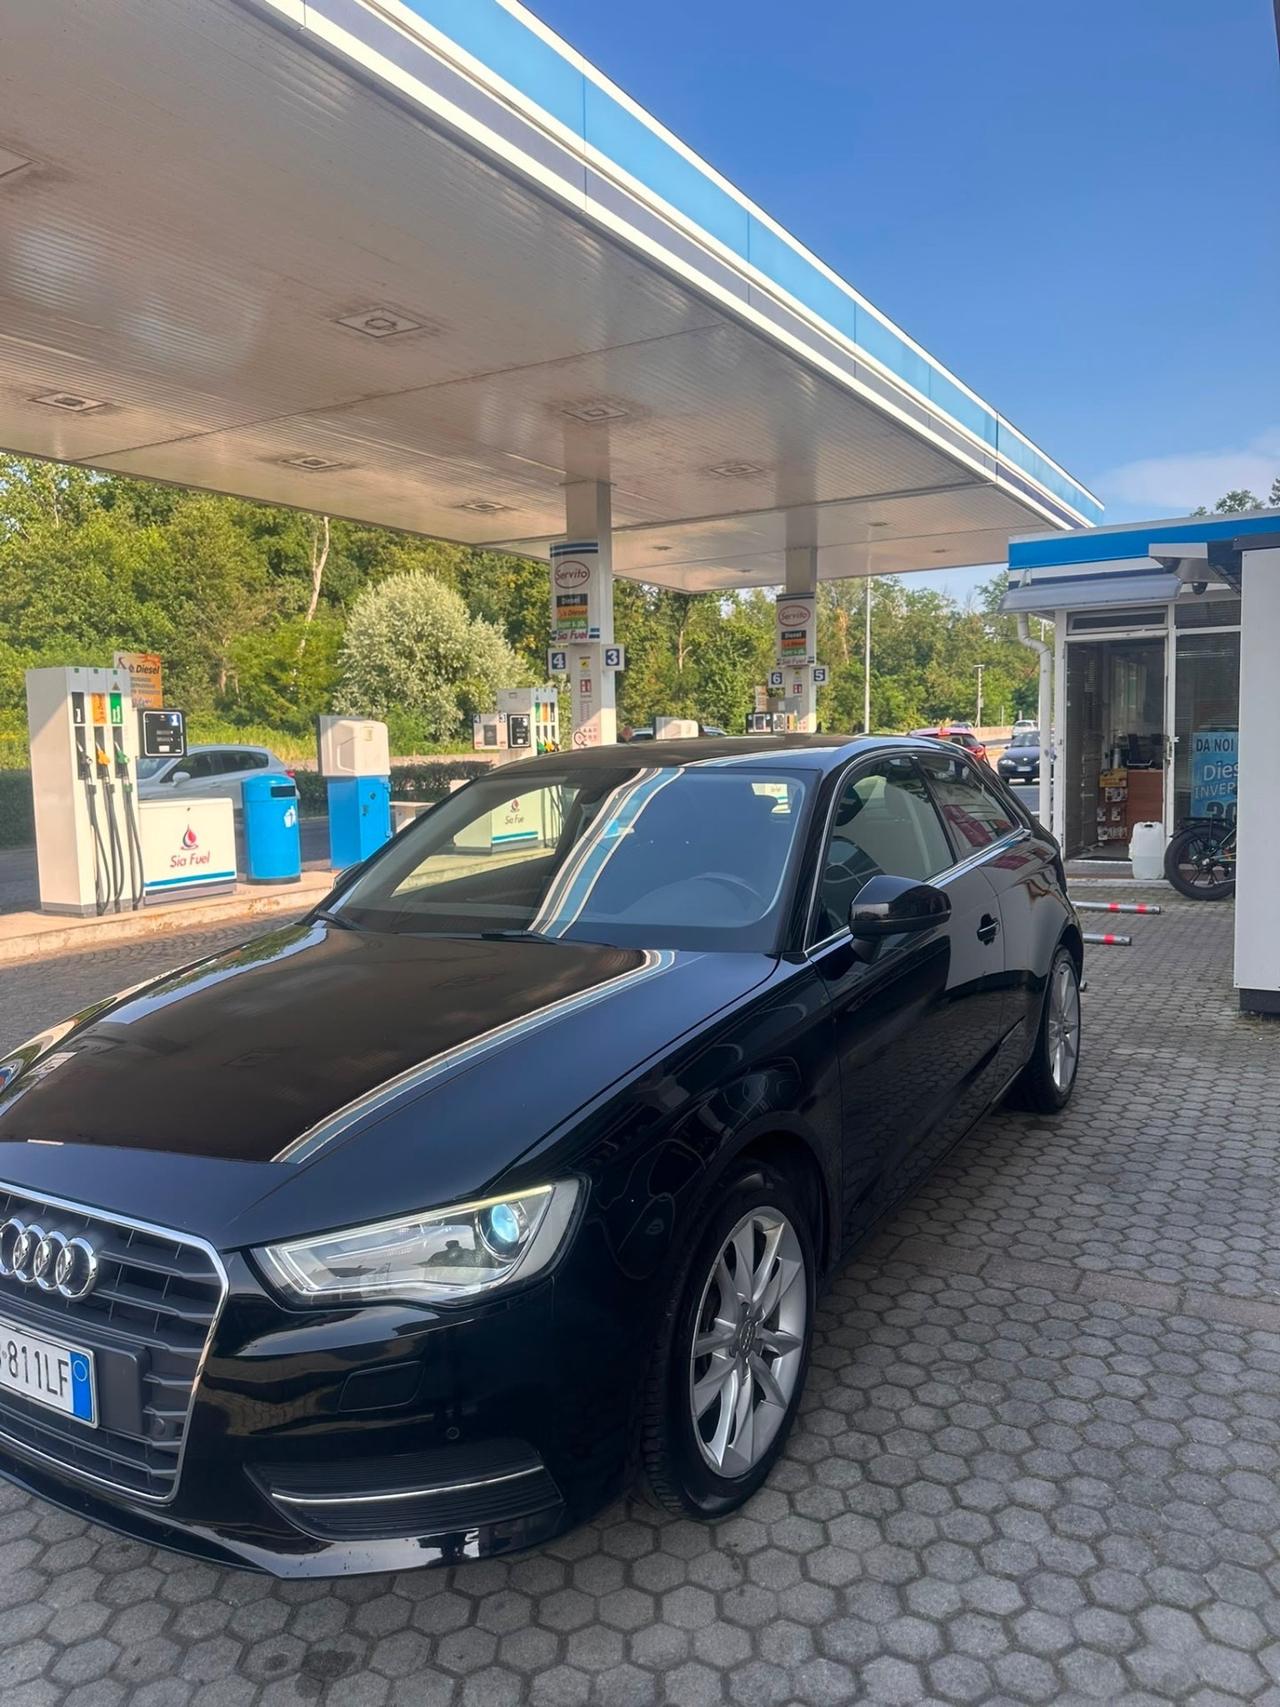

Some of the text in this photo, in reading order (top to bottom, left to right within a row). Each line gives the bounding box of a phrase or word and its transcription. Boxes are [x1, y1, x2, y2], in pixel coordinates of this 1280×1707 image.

[553, 653, 564, 668] 4
[607, 650, 618, 665] 3
[136, 664, 160, 675] Diesel
[815, 670, 824, 681] 5
[772, 674, 781, 684] 6
[171, 714, 179, 726] 1
[1196, 738, 1234, 752] DA NOI
[170, 849, 211, 868] Sia Fuel
[0, 1340, 69, 1397] 811LF
